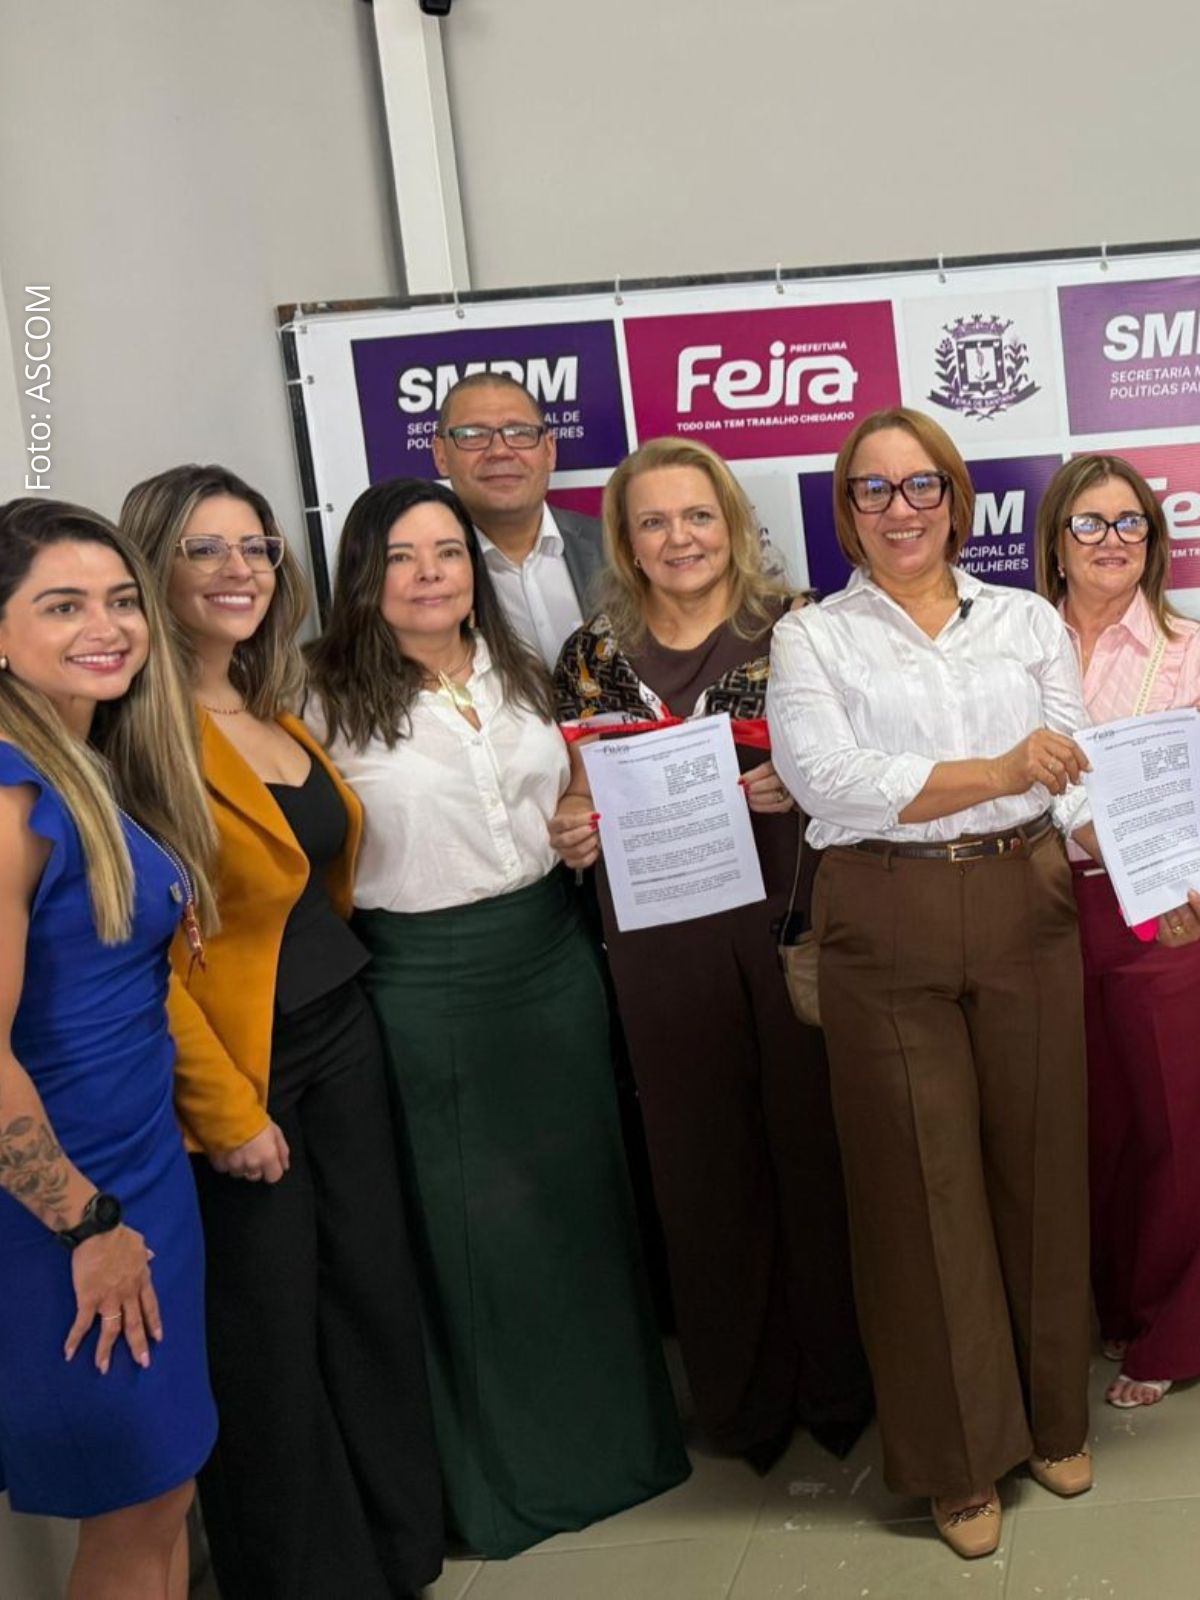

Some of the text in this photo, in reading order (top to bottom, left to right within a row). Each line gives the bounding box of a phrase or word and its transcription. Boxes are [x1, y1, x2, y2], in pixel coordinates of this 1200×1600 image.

[789, 341, 848, 353] PREFEITURA
[677, 340, 858, 413] Feira
[1110, 366, 1192, 383] SECRETARIA
[1109, 383, 1179, 399] POLÍTICAS
[562, 410, 581, 424] DE
[677, 411, 855, 431] TODO DIA TEM TRABALHO CHEGANDO
[553, 426, 585, 439] ERES
[958, 542, 1026, 559] NICIPAL DE
[1170, 548, 1188, 559] EM
[960, 558, 1030, 573] MULHERES
